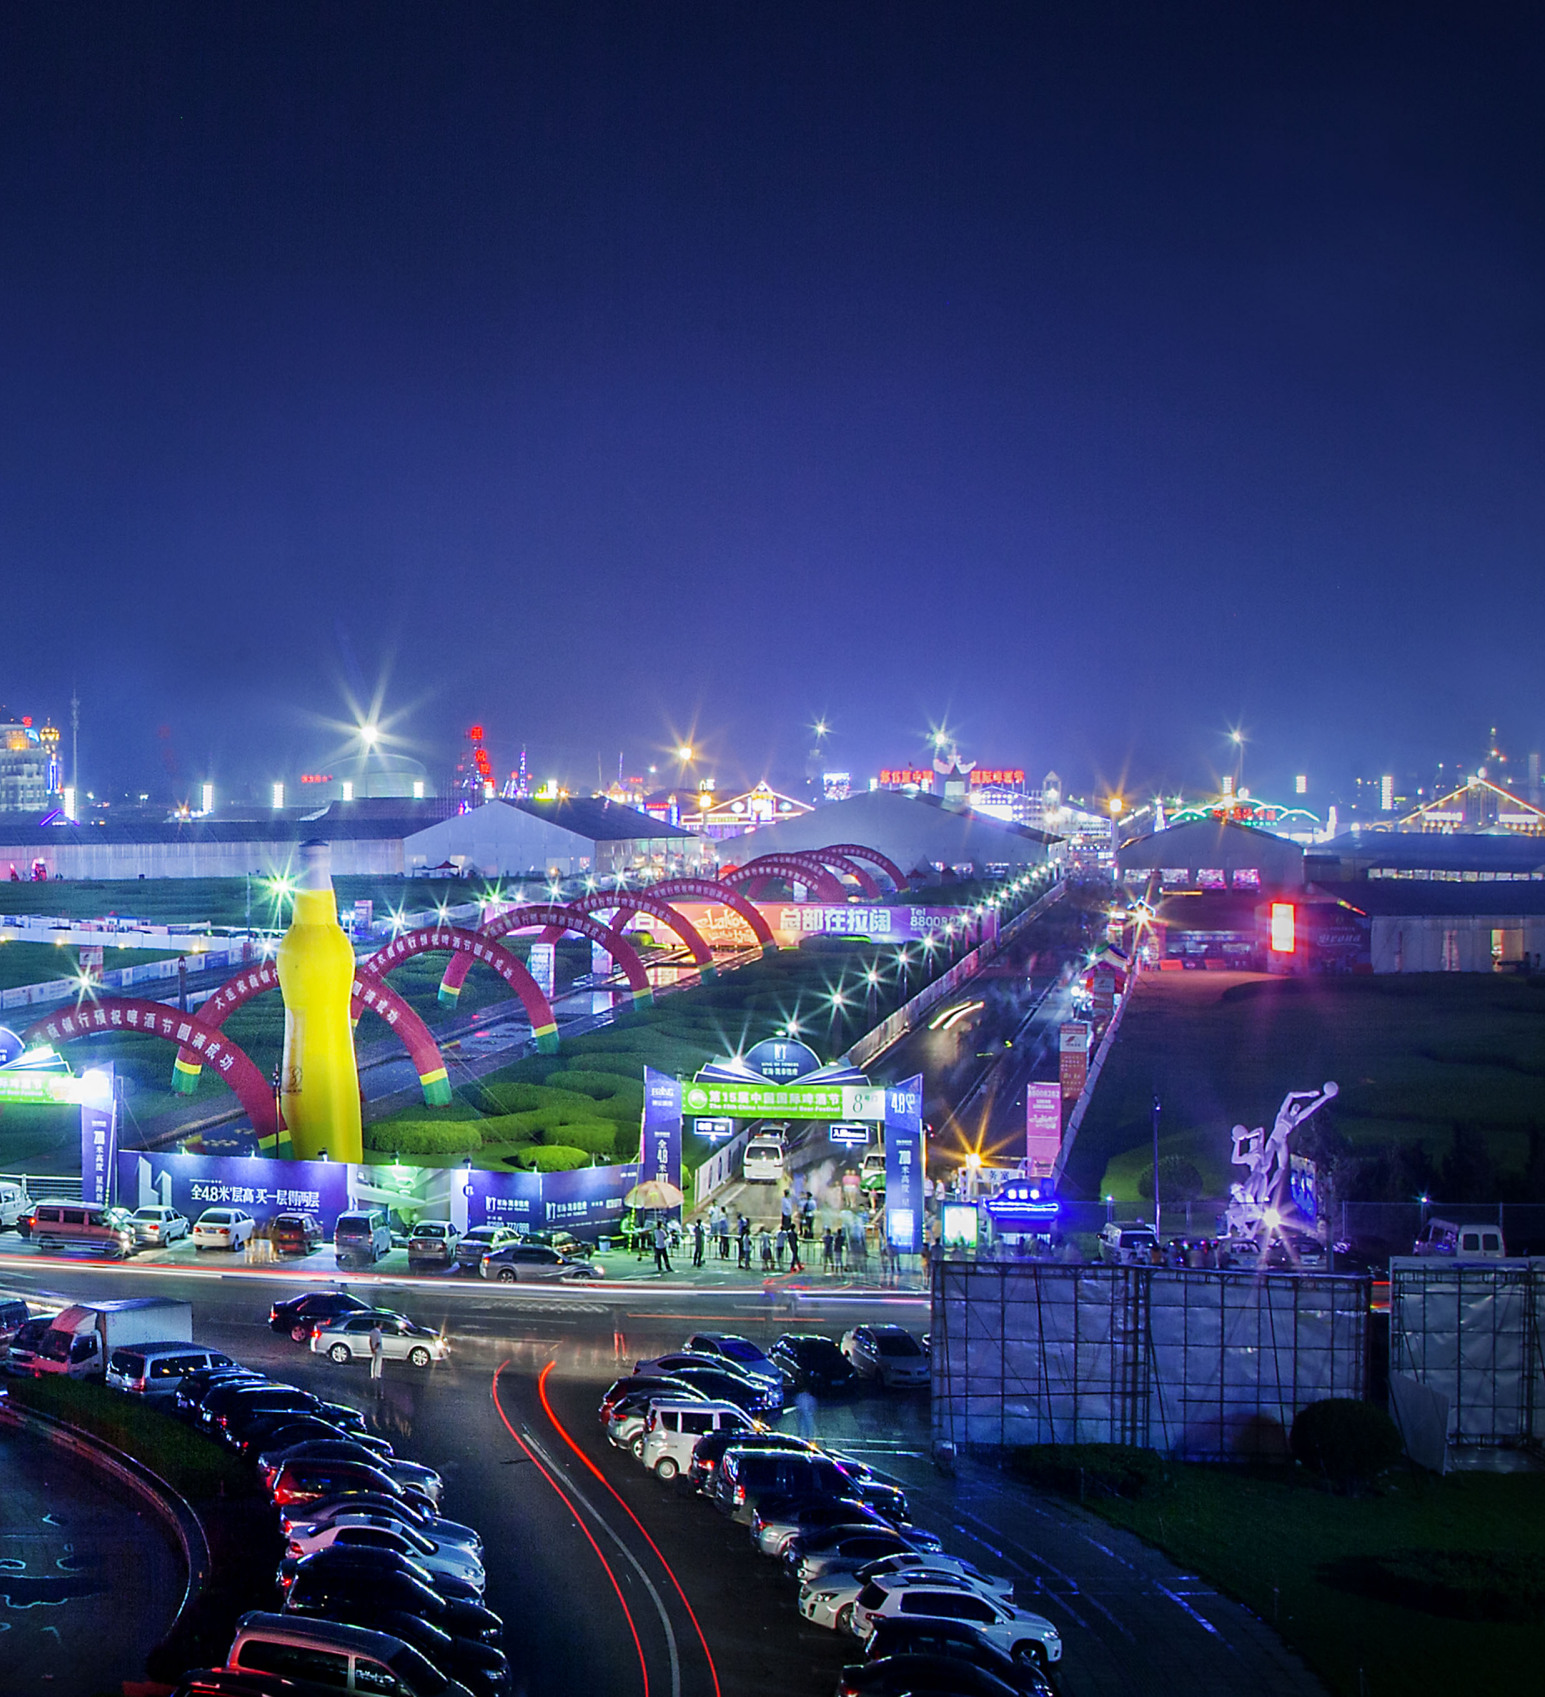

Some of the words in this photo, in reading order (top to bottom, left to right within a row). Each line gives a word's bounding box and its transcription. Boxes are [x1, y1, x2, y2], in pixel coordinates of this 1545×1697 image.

[780, 908, 891, 932] 总部在拉阔
